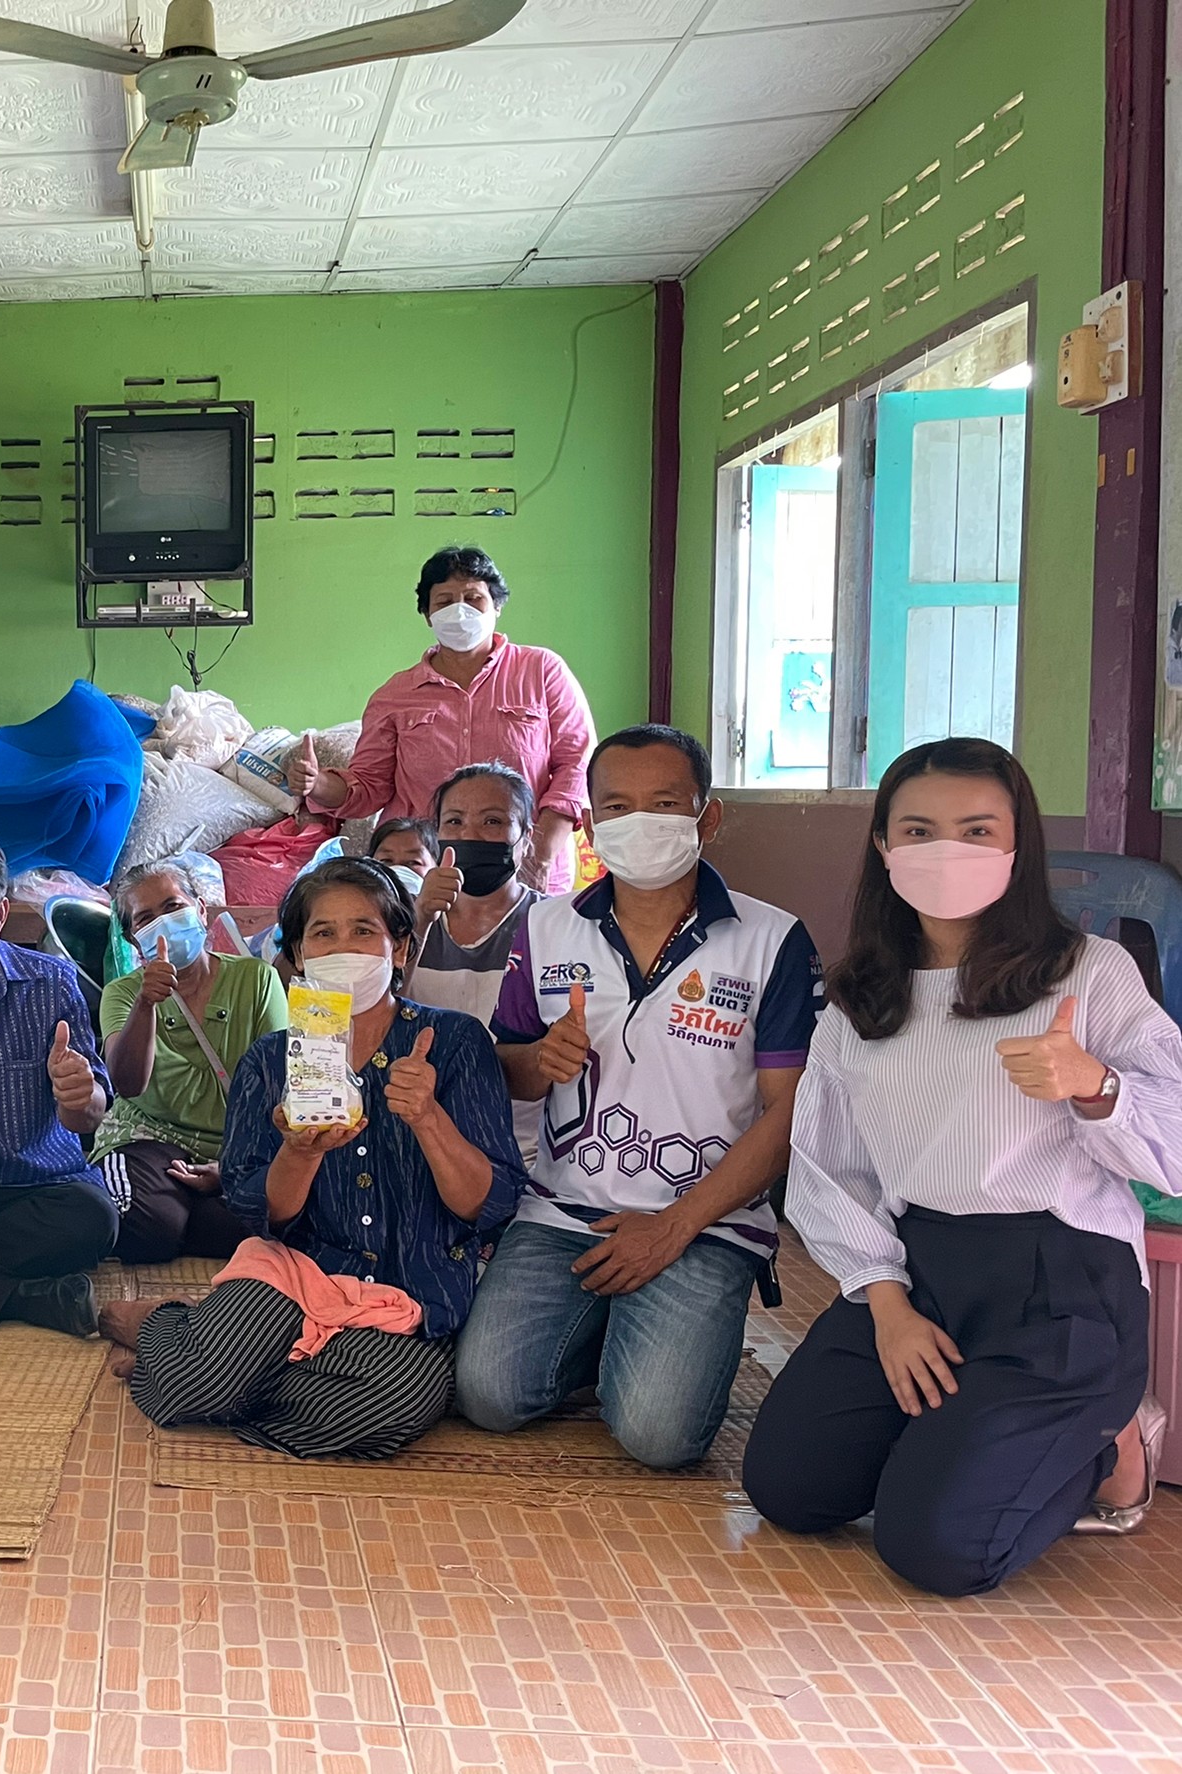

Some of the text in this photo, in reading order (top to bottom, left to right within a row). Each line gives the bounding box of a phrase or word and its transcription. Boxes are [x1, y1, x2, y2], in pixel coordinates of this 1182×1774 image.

[540, 962, 591, 981] ZERO
[711, 986, 752, 1002] สกลนคร
[717, 976, 755, 994] สพป.
[708, 994, 749, 1013] เขต 3
[669, 1003, 748, 1037] วิถีใหม่
[667, 1023, 737, 1050] วิถีคุณภาพ
